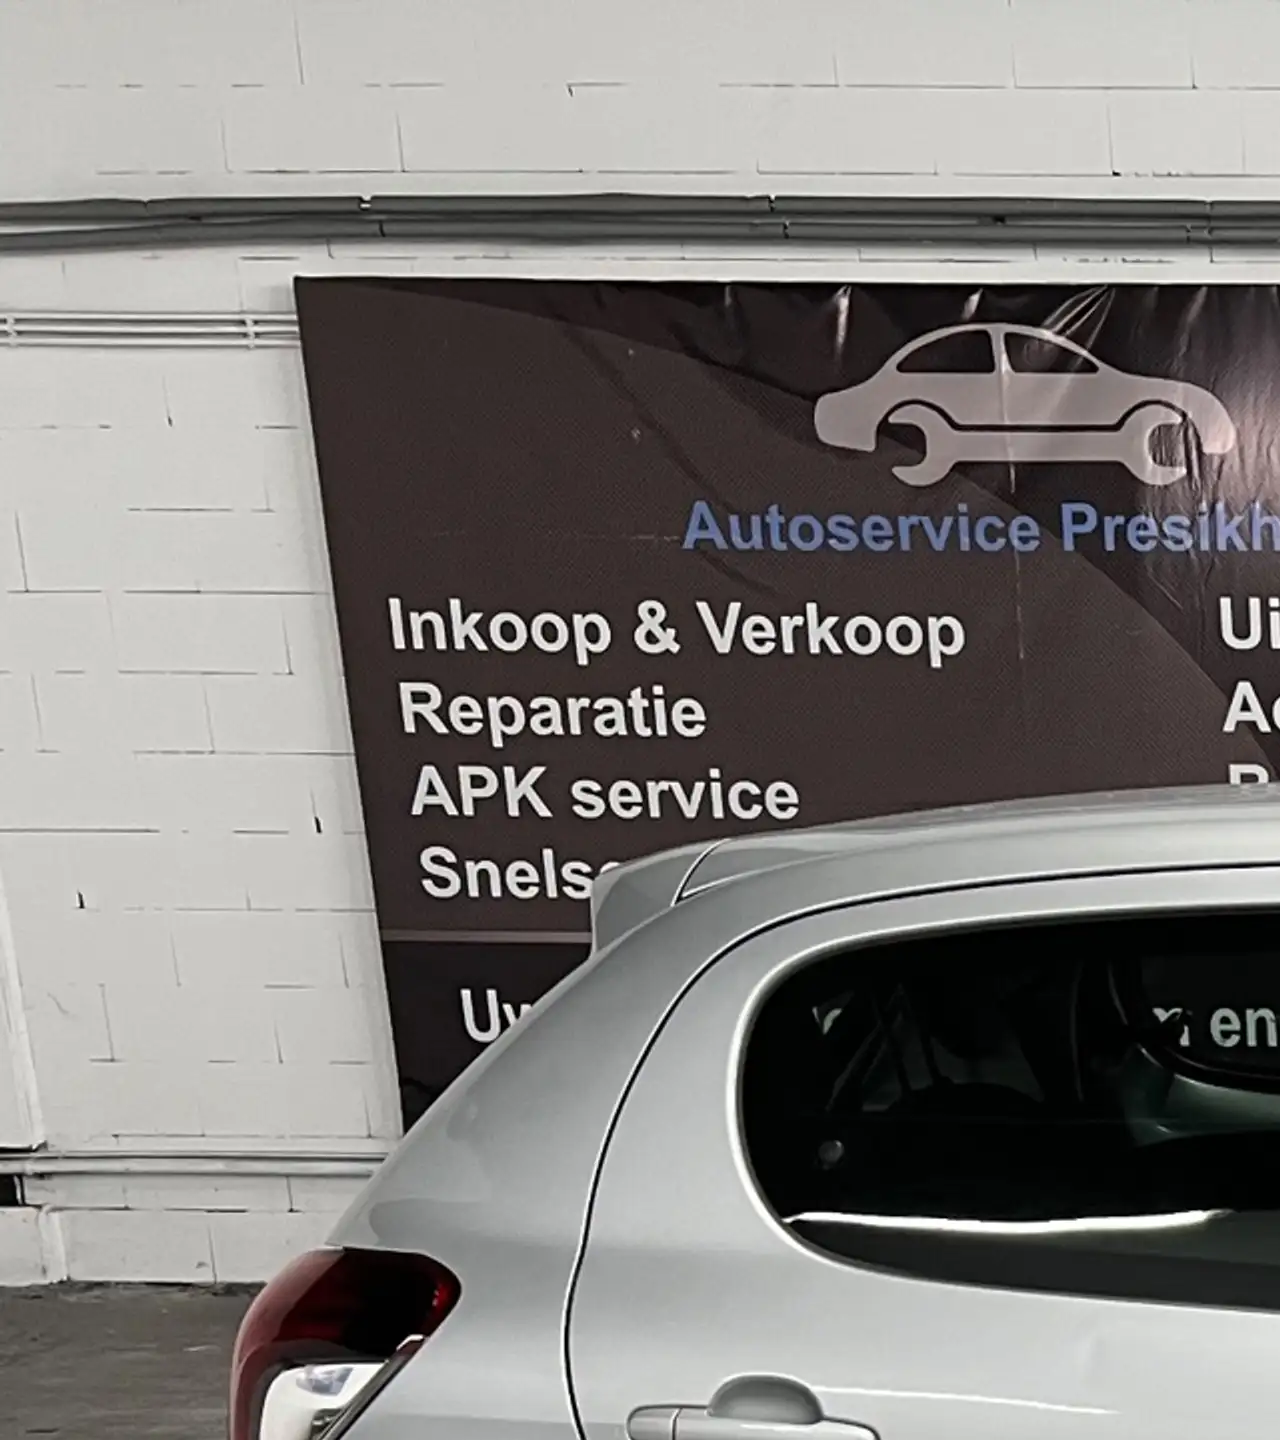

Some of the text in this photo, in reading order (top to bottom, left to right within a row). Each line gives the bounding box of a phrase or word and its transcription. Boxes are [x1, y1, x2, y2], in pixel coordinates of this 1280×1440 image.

[682, 502, 1041, 552] Autoservice
[388, 597, 966, 668] Inkoop & Verkoop
[399, 681, 707, 747] Reparatie
[411, 765, 800, 821] APK service
[419, 846, 620, 899] Snels
[1209, 1007, 1278, 1048] en
